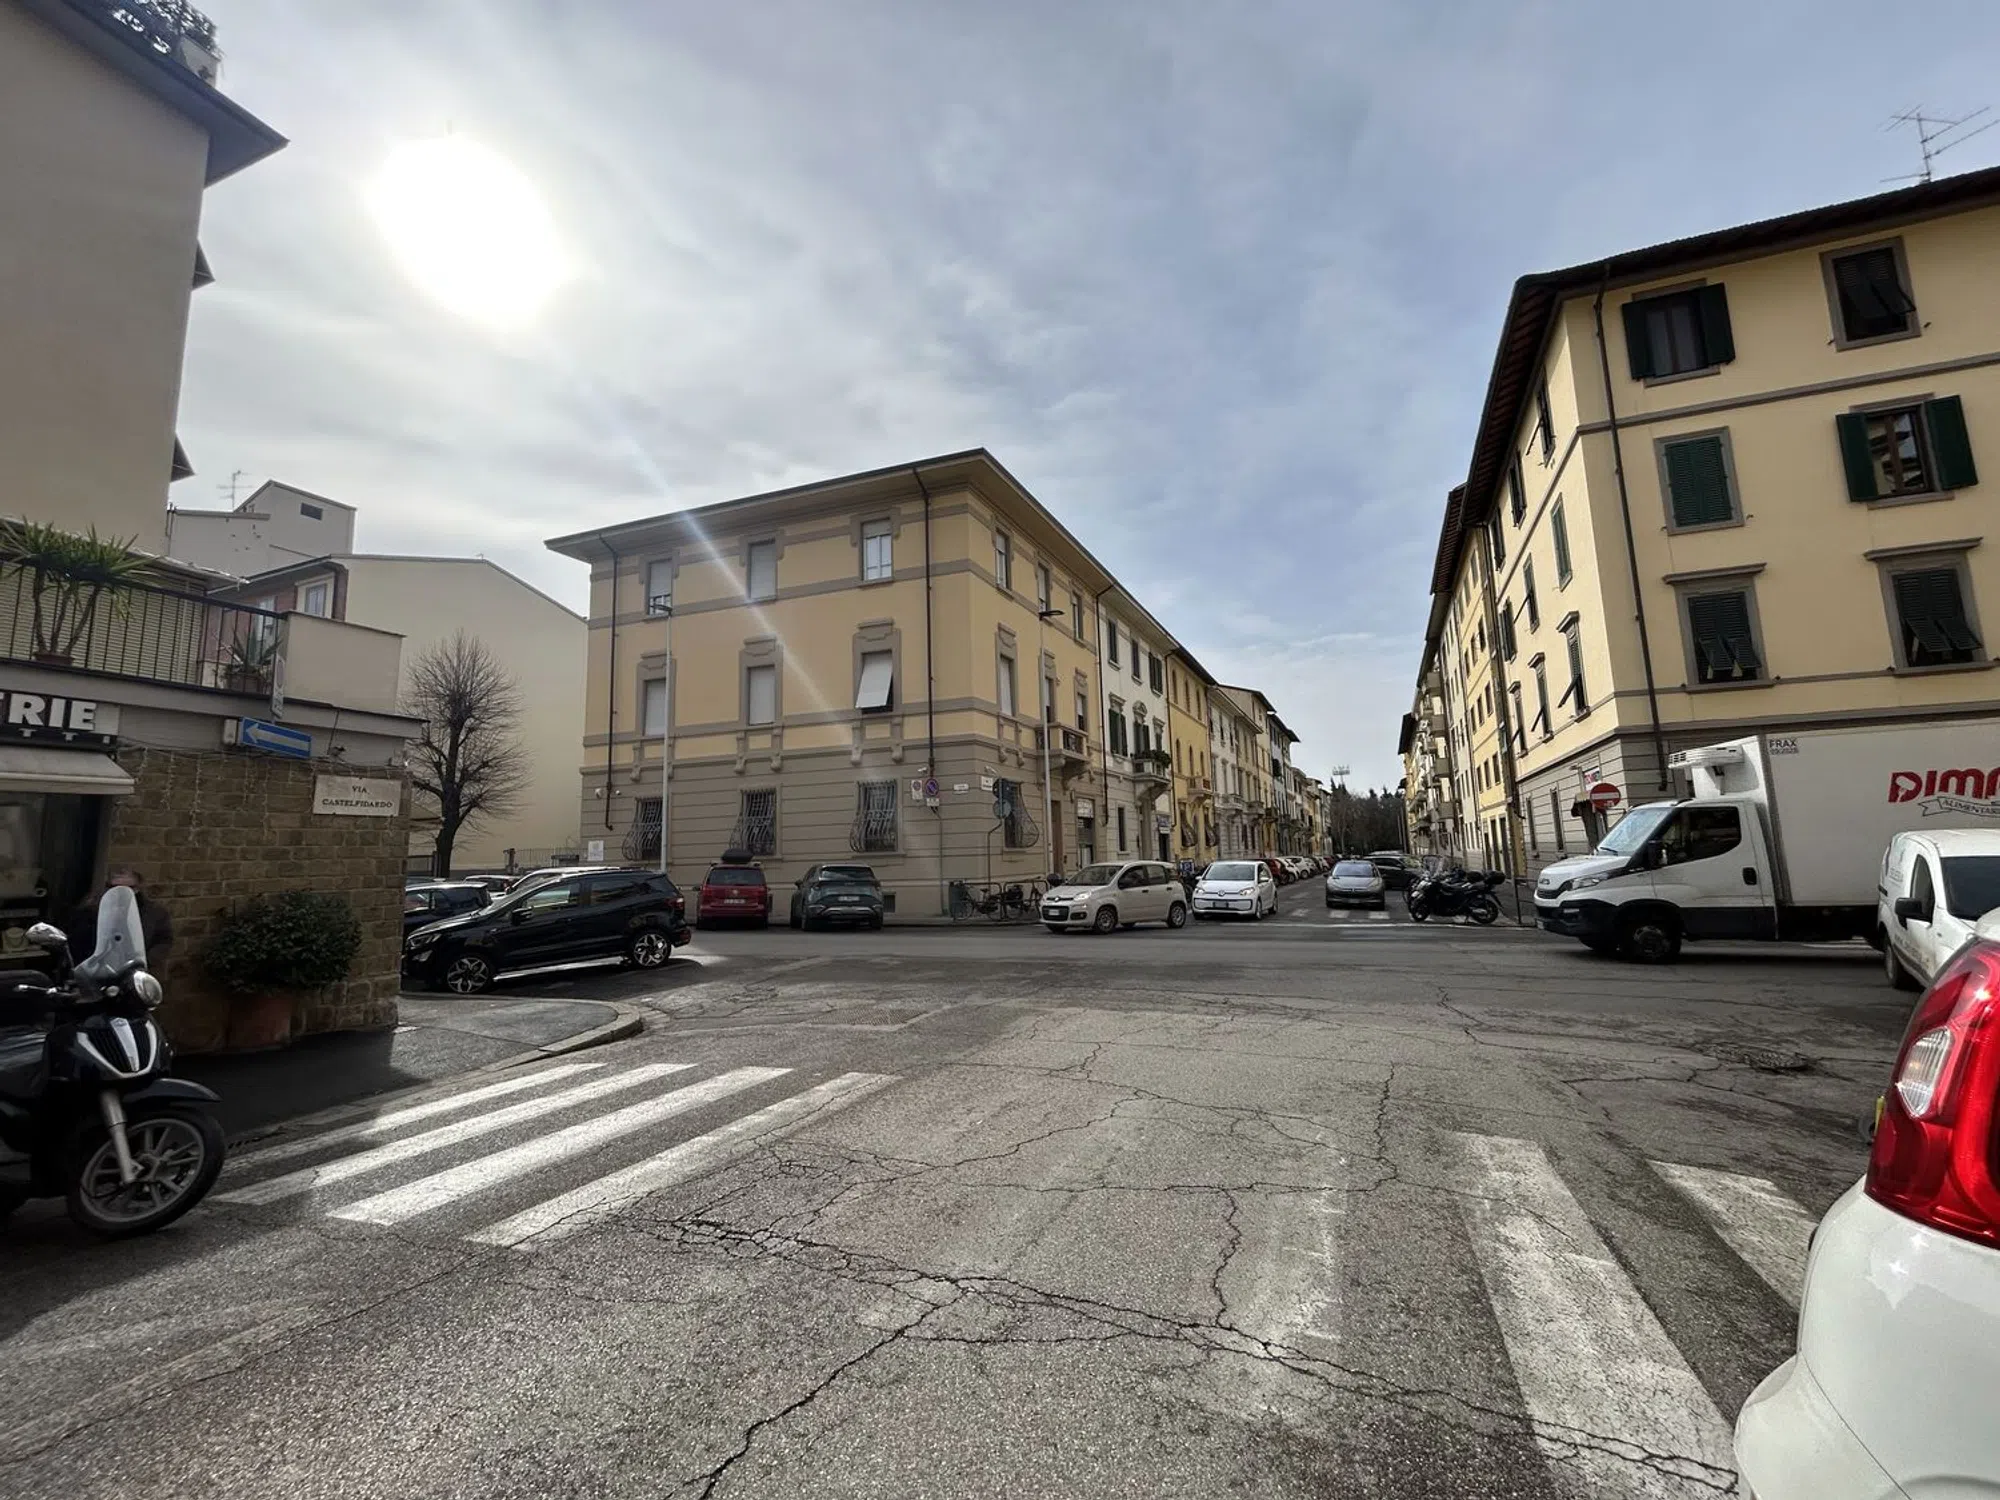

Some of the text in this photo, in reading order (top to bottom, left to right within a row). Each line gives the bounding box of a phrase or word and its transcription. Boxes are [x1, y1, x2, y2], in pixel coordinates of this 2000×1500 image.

[0, 691, 97, 732] RIE
[1769, 738, 1798, 748] FRAX
[352, 785, 368, 794] VIA
